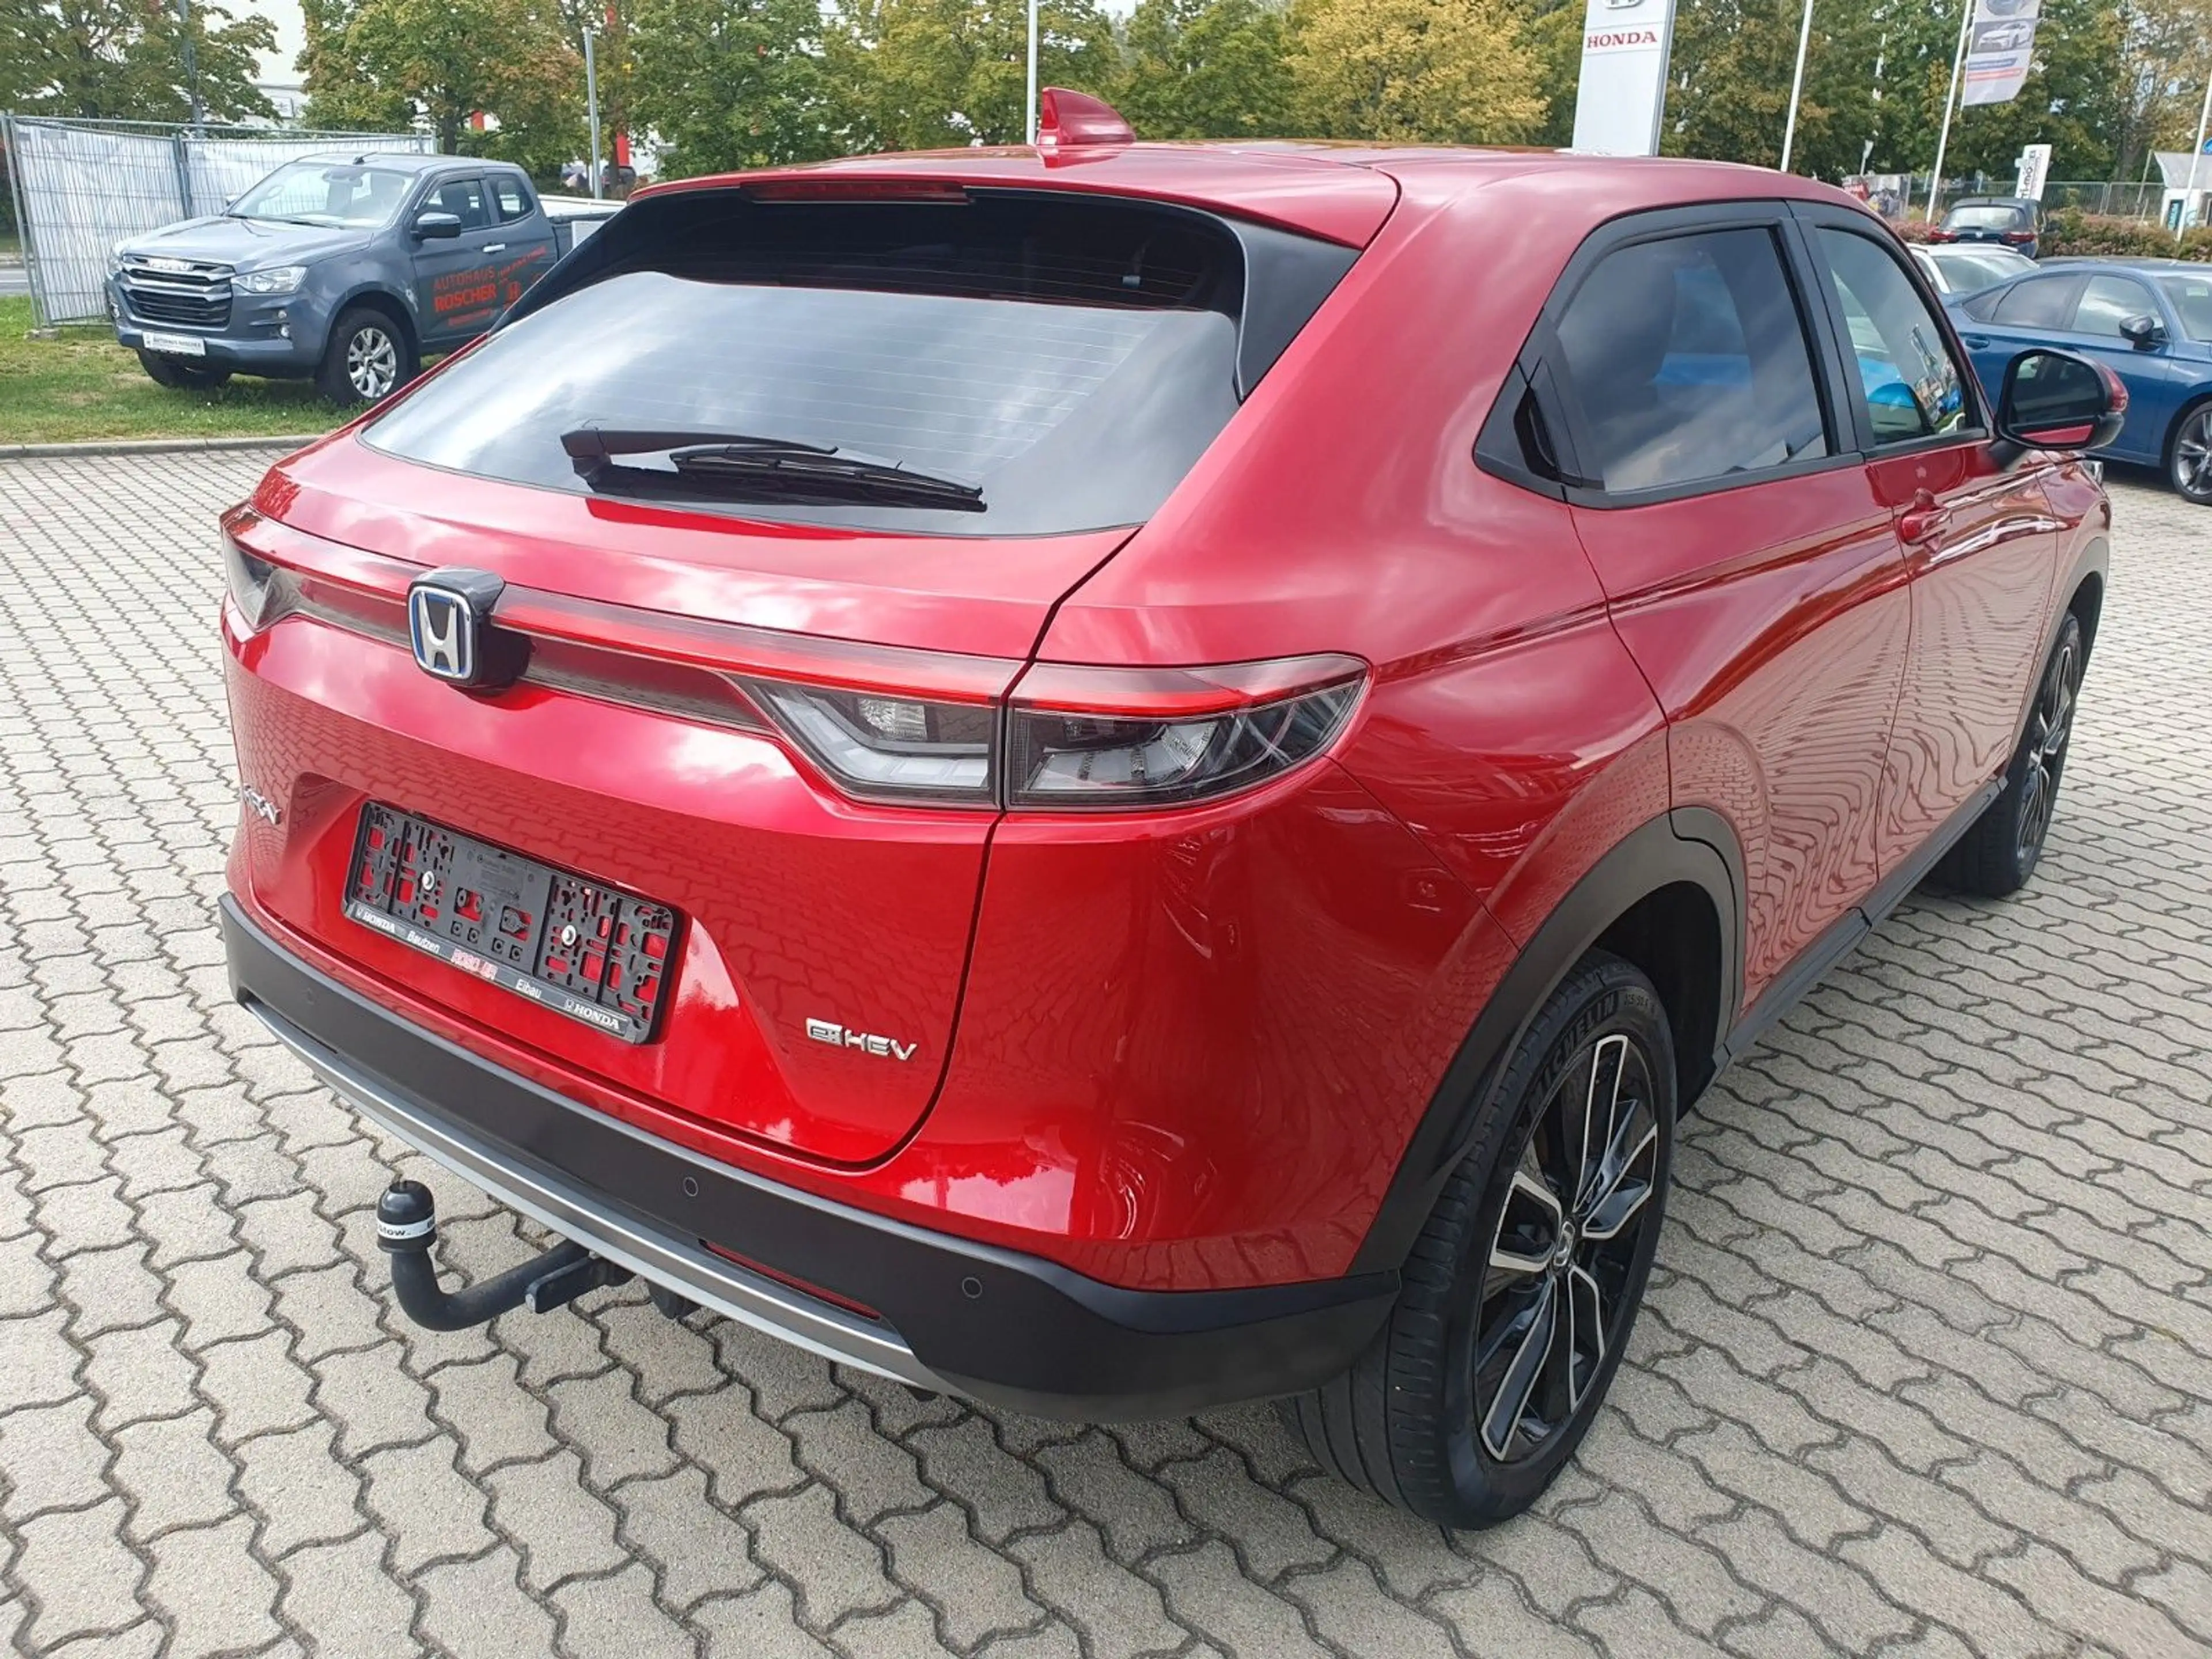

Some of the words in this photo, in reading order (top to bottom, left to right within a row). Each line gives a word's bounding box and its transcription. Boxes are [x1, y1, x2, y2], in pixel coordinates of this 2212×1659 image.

[1587, 31, 1657, 48] HONDA
[434, 266, 495, 289] AUTOHAUS
[363, 909, 395, 933] HONDA
[575, 1003, 620, 1030] HONDA
